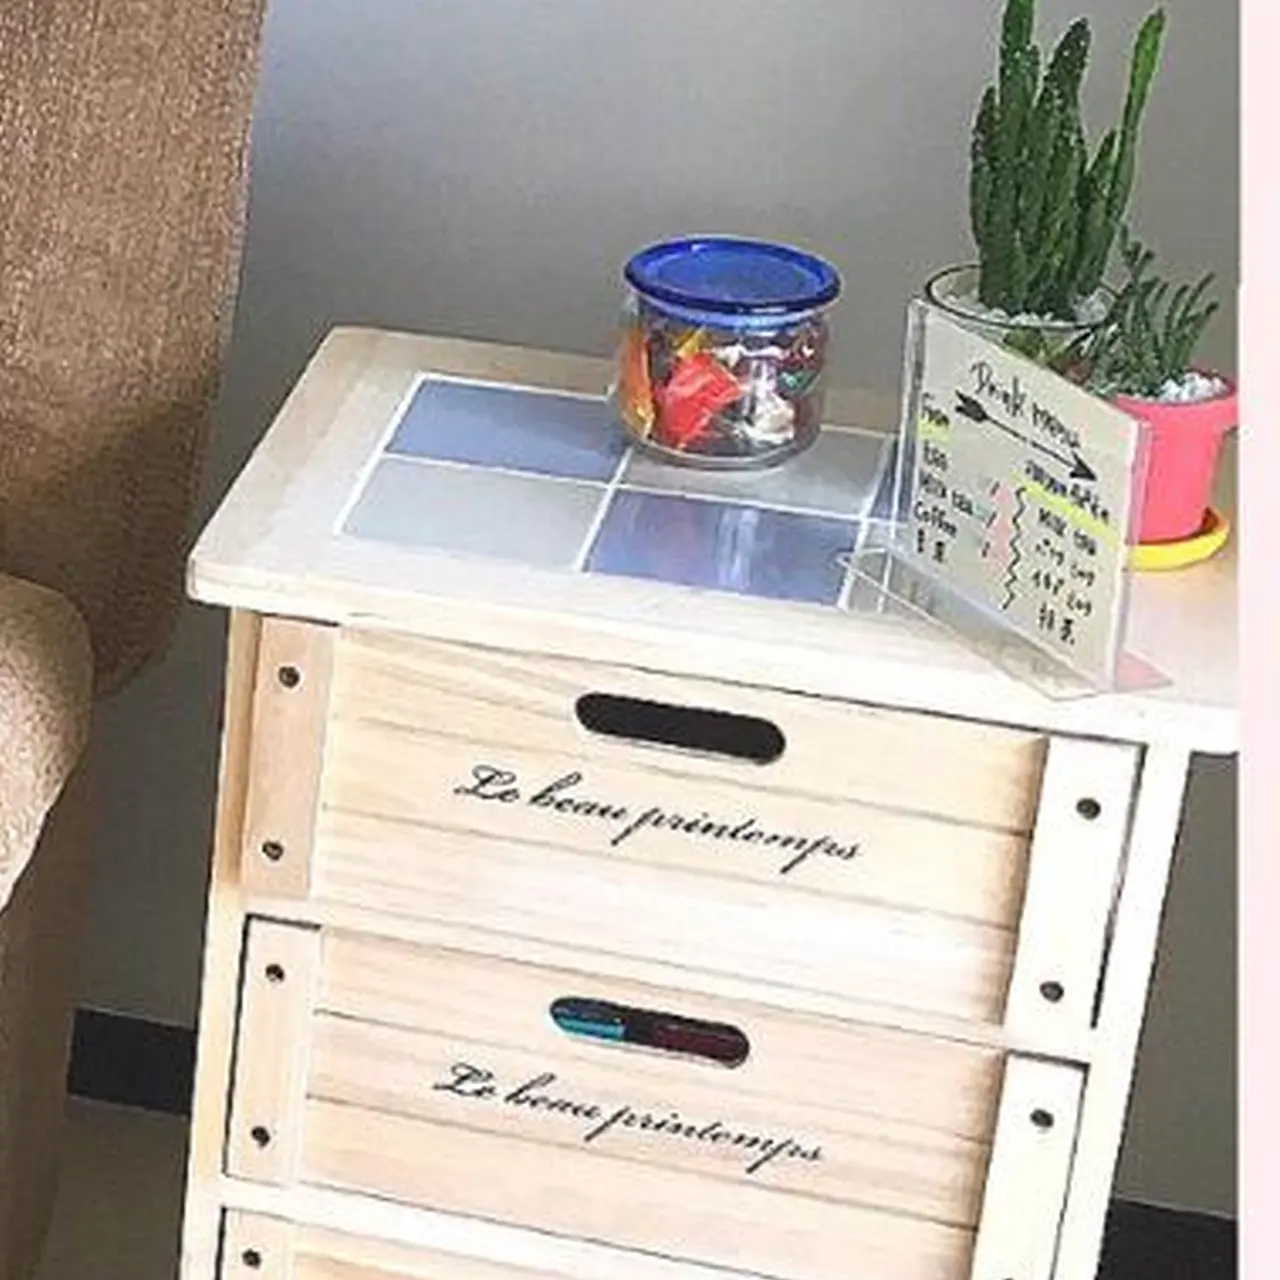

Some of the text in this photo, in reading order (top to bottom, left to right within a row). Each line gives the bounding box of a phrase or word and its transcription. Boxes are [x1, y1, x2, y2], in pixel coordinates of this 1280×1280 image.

[453, 764, 862, 875] Le beau printemps
[433, 1062, 824, 1175] Le beau printemps
